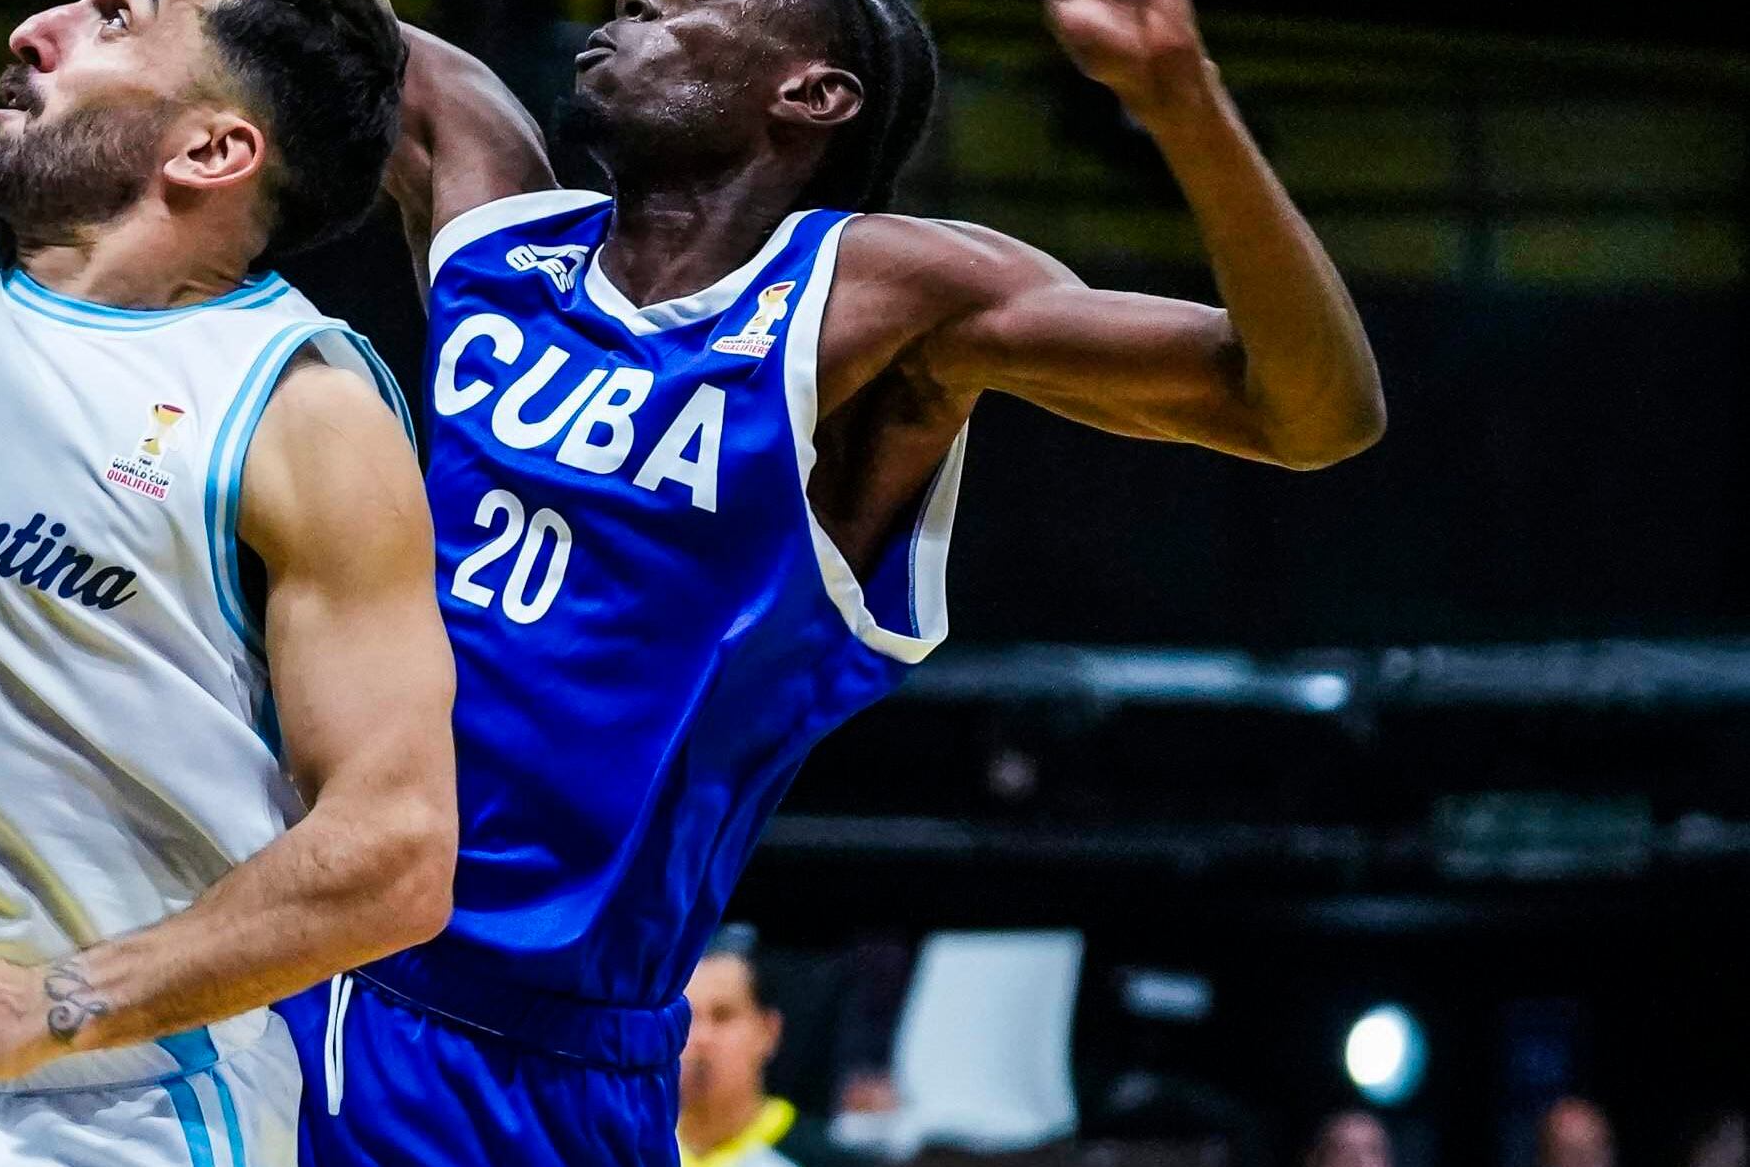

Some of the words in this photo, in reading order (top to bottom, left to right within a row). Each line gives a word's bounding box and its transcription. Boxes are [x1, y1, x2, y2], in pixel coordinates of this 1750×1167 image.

[434, 313, 726, 513] CUBA
[106, 469, 167, 499] QUALIFIERS
[112, 461, 147, 480] WORLD
[149, 475, 169, 486] CUP
[450, 489, 572, 624] 20
